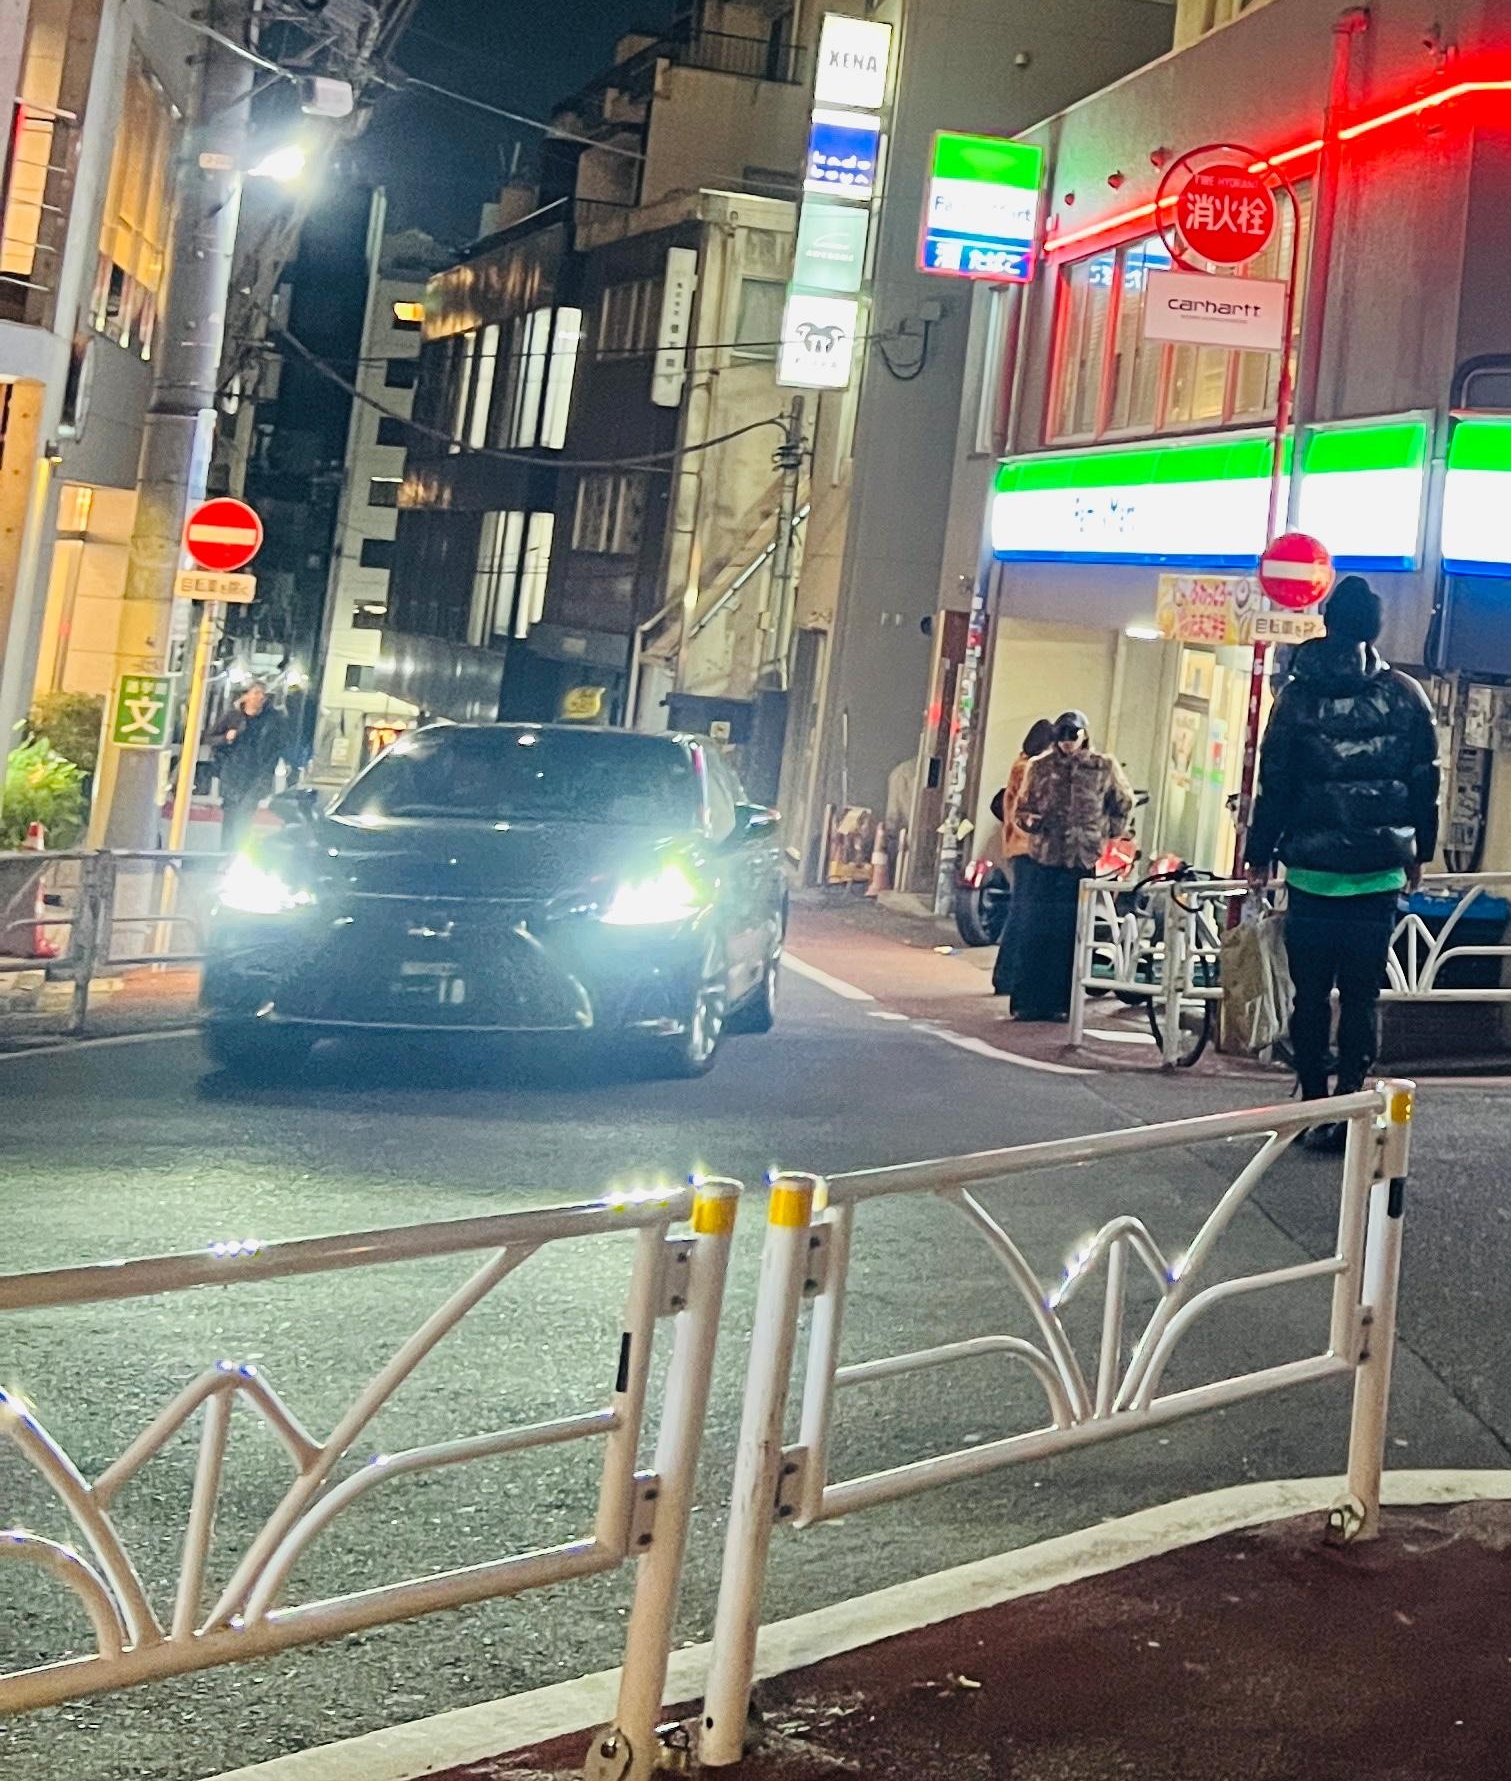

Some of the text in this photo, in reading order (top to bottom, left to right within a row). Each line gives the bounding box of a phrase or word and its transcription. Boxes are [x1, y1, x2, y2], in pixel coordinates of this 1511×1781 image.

[1186, 193, 1268, 235] 消火栓
[1167, 298, 1262, 318] carhartt
